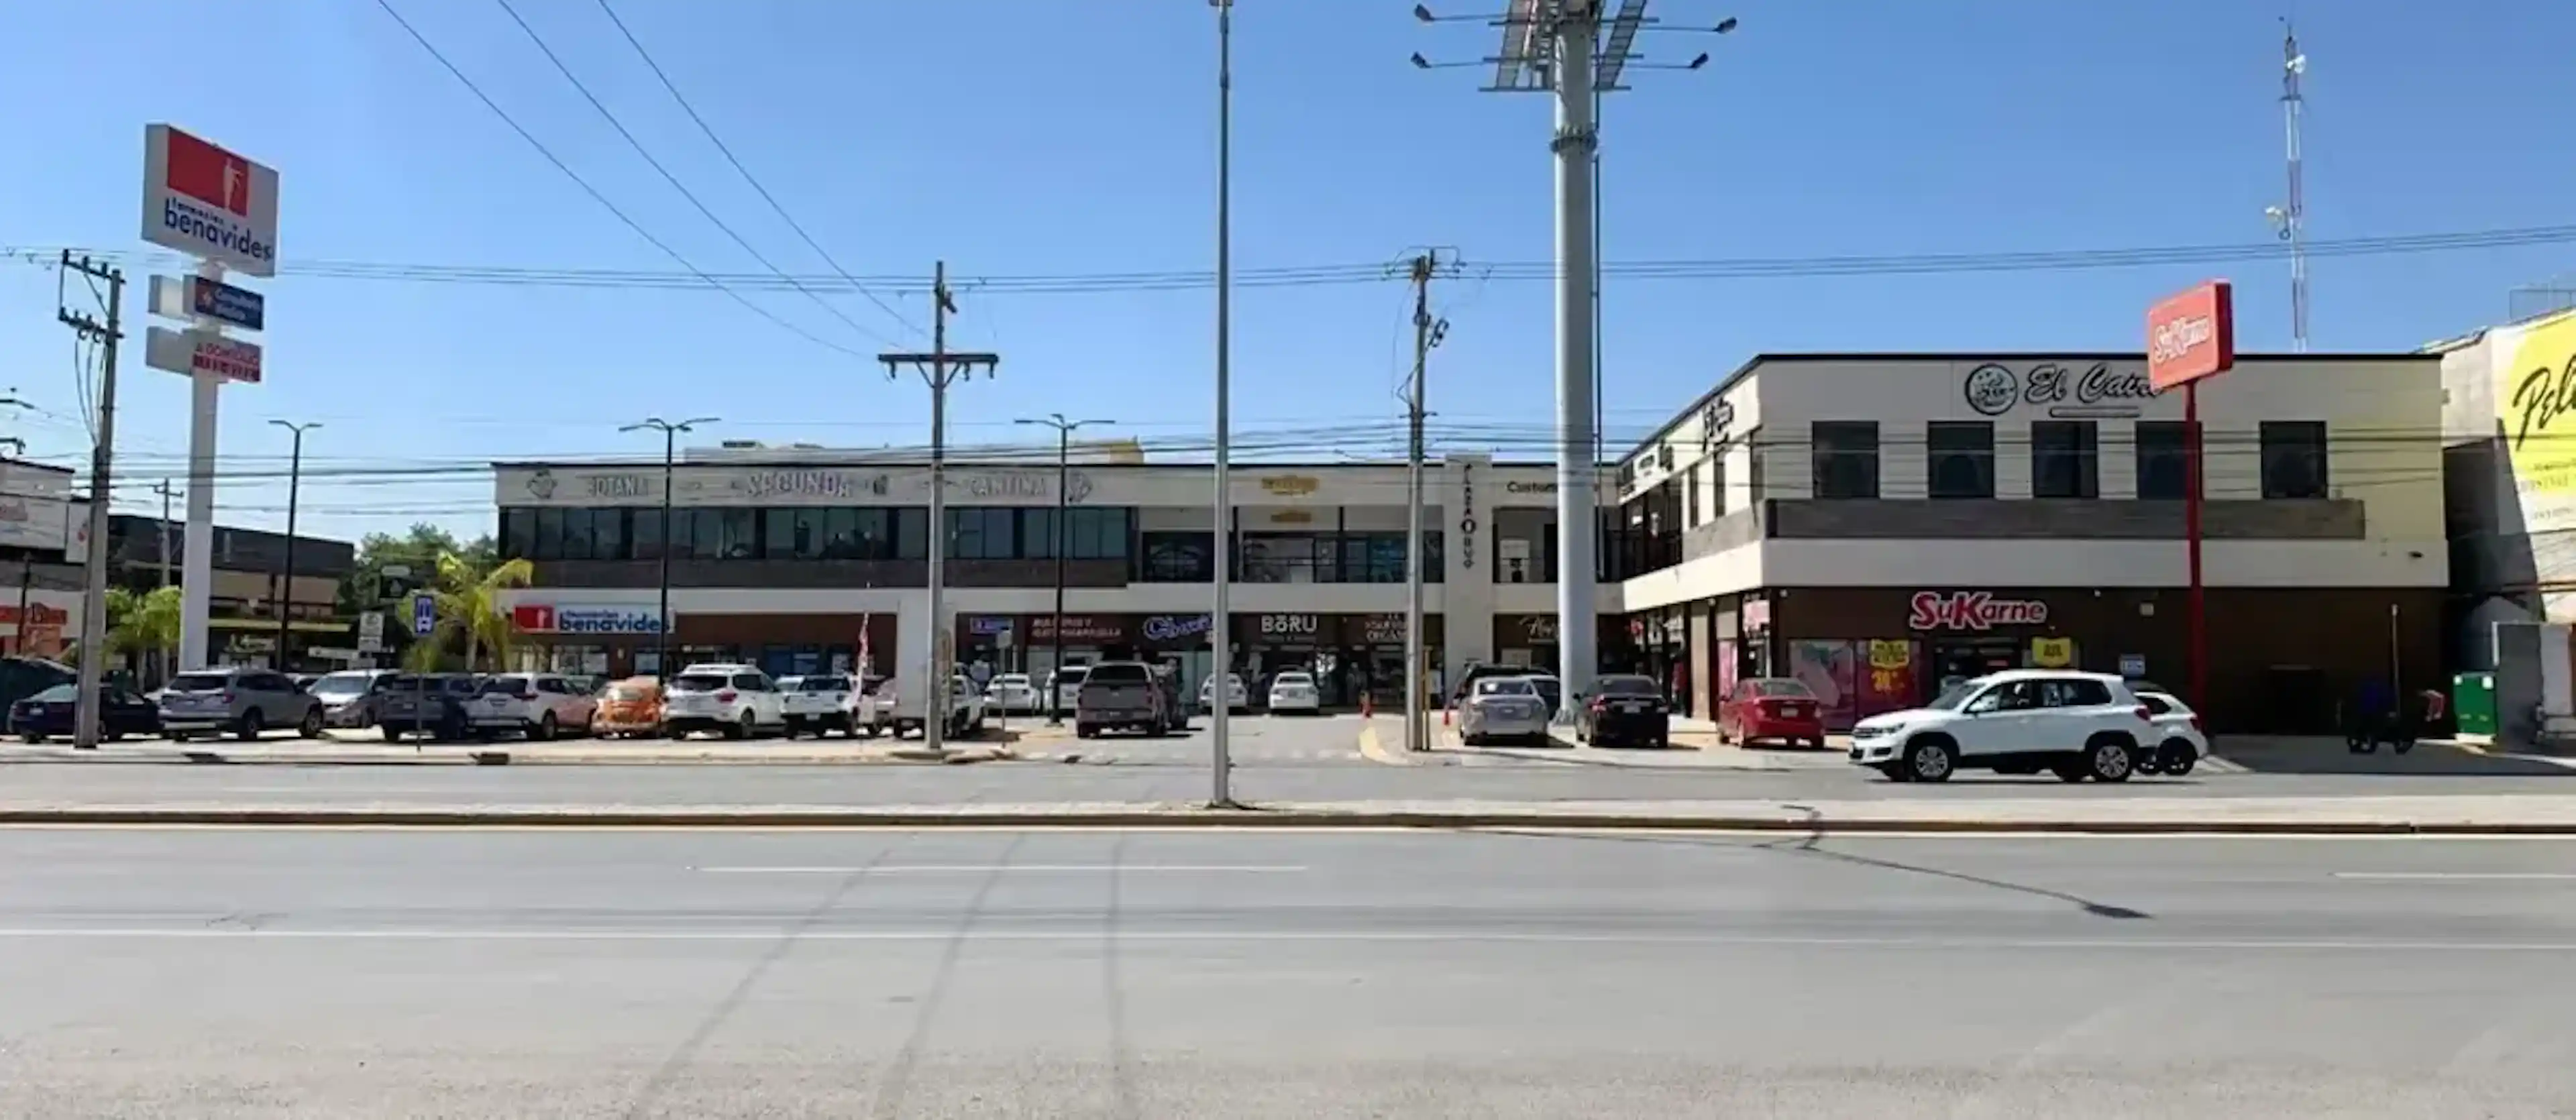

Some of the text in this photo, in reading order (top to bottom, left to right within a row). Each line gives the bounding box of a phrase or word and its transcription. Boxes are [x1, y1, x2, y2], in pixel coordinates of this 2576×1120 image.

[164, 197, 272, 263] benavides
[2025, 362, 2067, 403] El
[559, 610, 670, 632] benavide
[1909, 591, 2047, 630] SuKarne
